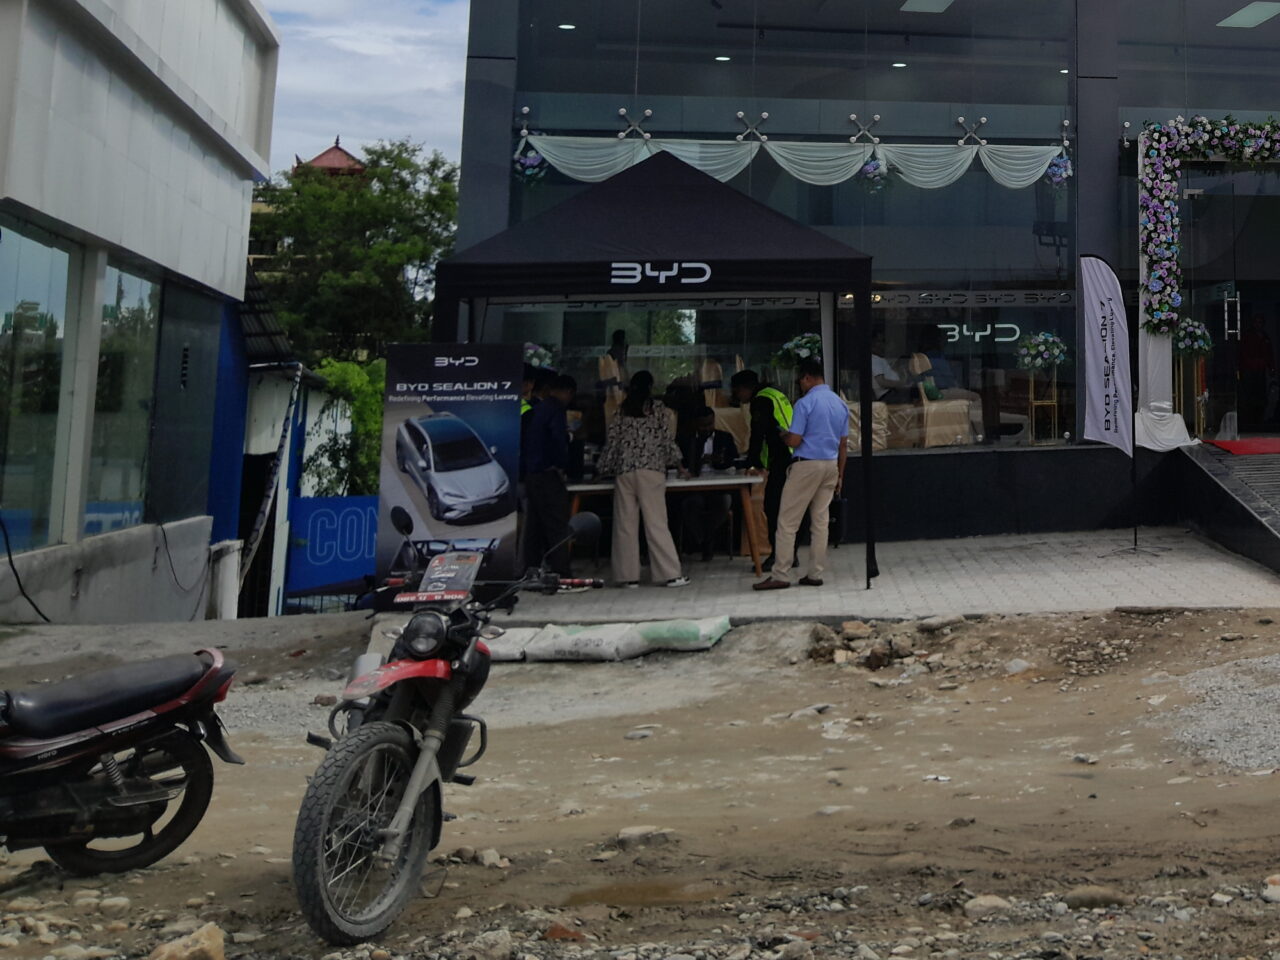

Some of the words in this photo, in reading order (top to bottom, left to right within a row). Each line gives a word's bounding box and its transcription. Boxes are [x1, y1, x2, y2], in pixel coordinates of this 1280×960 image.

[609, 261, 712, 284] BYD
[975, 293, 1017, 304] BYD
[1024, 292, 1072, 304] BYD
[936, 323, 1021, 343] BYD
[434, 356, 479, 367] BYD
[396, 382, 429, 392] BYD
[432, 382, 498, 391] SEALION
[501, 381, 512, 390] 7
